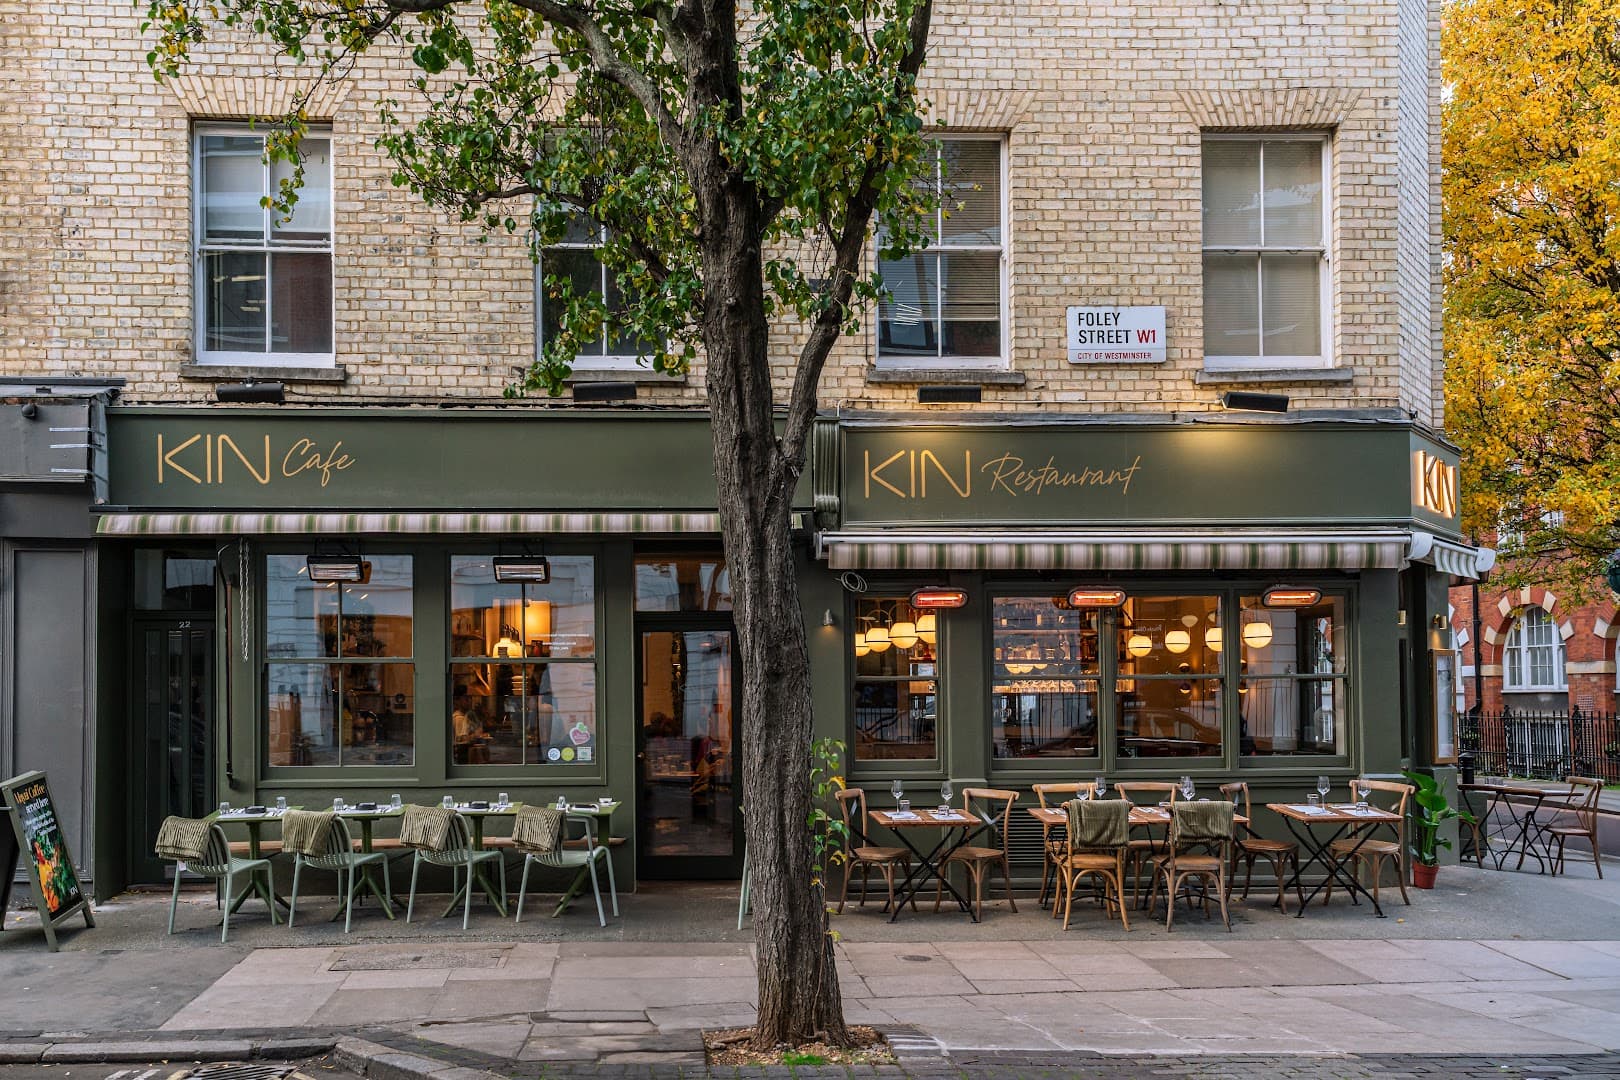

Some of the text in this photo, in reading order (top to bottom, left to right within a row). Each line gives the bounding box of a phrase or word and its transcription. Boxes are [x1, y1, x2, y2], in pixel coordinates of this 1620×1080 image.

[1078, 312, 1120, 326] FOLEY
[1079, 329, 1156, 344] STREET W1
[157, 433, 356, 487] KIN Cafe
[864, 449, 1141, 498] KIN Restaurant
[1422, 451, 1456, 518] KIN
[29, 784, 46, 798] Coffee
